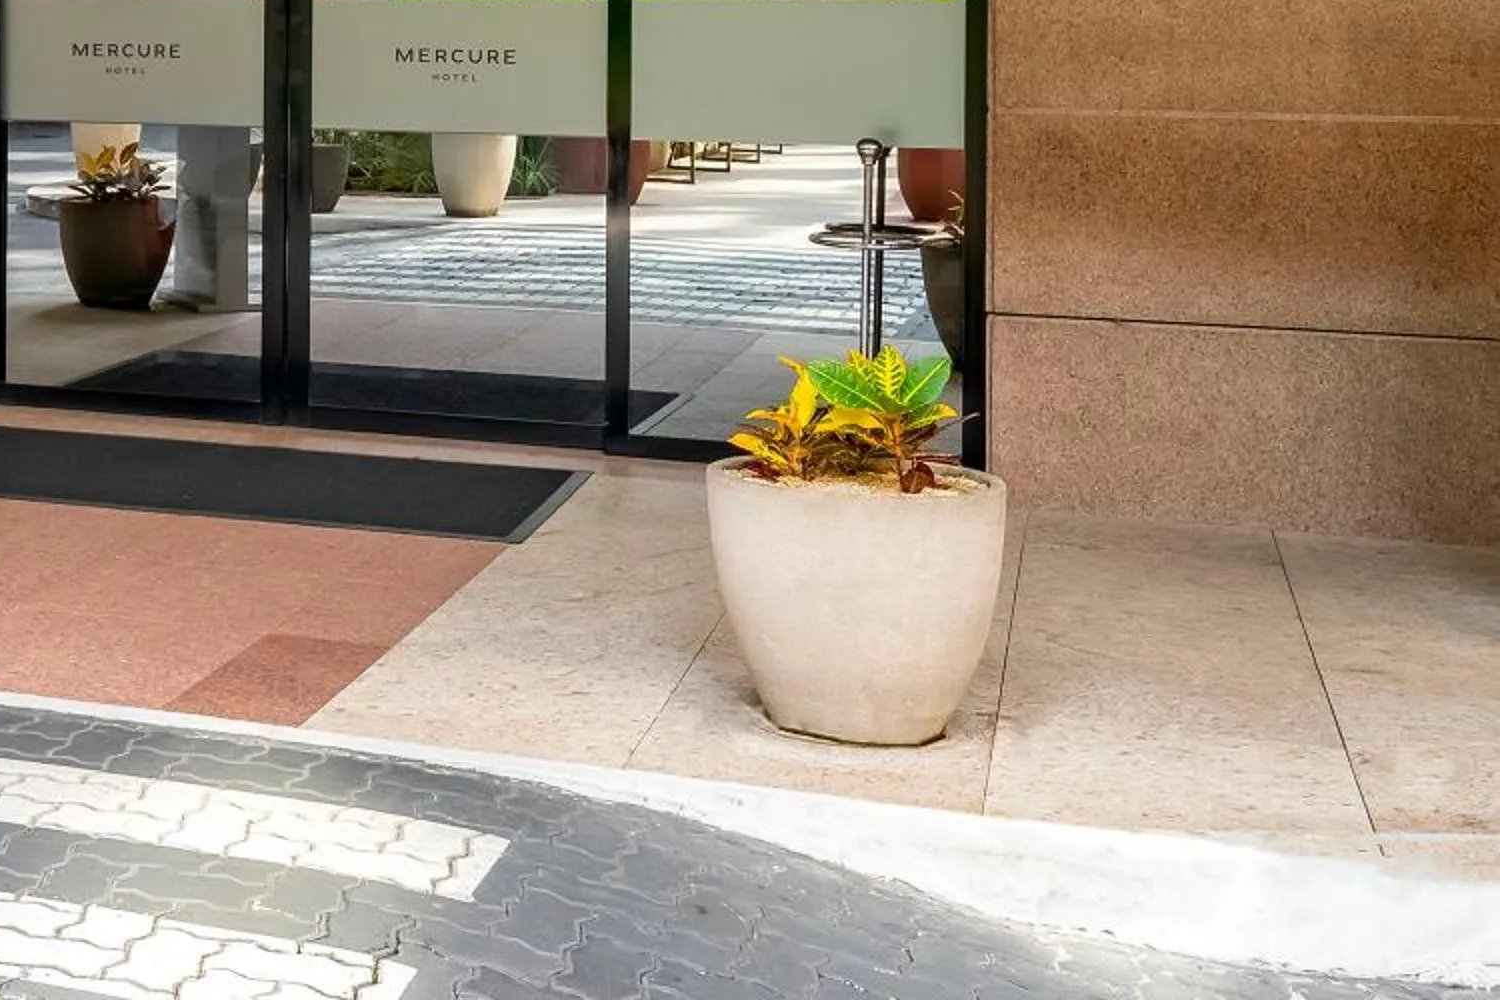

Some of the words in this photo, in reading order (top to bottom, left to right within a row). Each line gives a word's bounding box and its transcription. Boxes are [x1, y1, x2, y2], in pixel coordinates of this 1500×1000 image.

[71, 43, 181, 59] MERCURE
[395, 48, 517, 65] MERCURE
[105, 66, 146, 75] HOTEL
[431, 73, 476, 82] HOTEL
